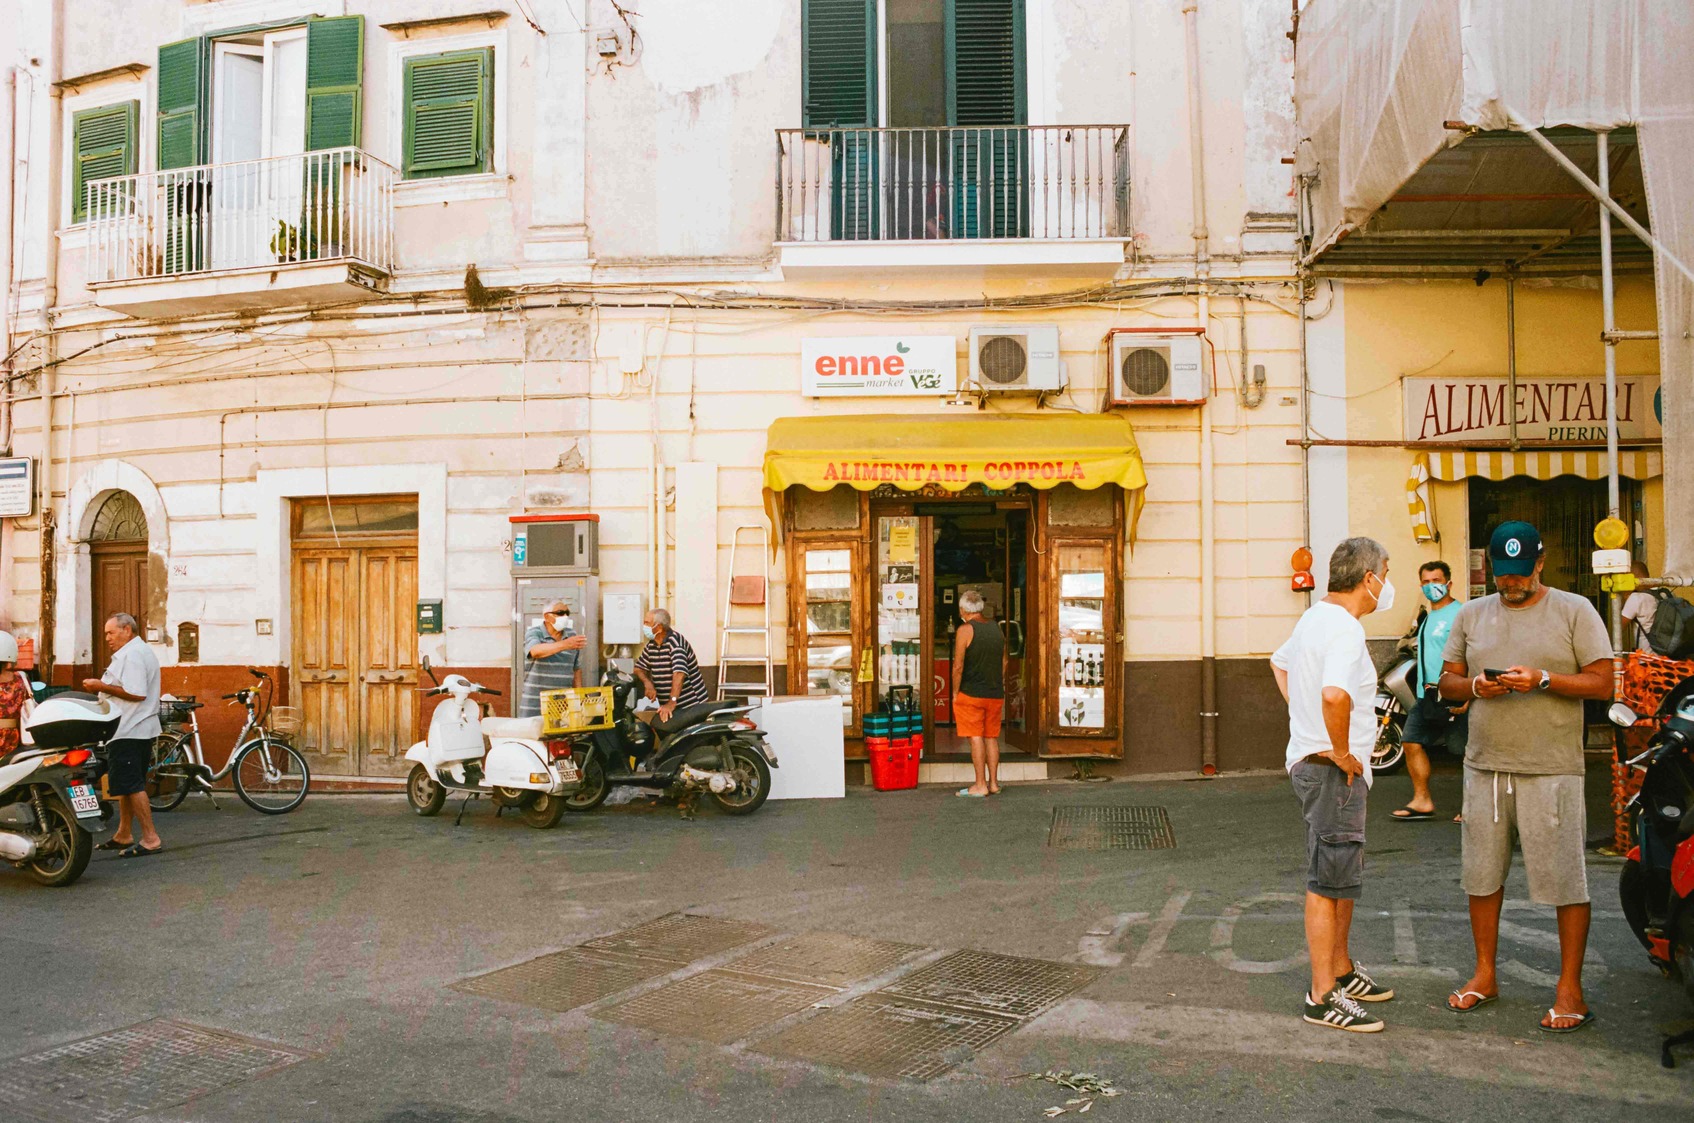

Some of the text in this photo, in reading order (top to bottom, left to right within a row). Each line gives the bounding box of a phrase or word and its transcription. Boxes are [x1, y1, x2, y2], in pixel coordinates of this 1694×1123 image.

[815, 355, 905, 377] enne
[865, 377, 904, 388] market
[1548, 427, 1621, 440] PIERIN
[823, 461, 1085, 482] ALIMENTARI COPPOLA
[1509, 542, 1518, 551] N
[73, 786, 85, 797] EB
[74, 797, 98, 810] 16765
